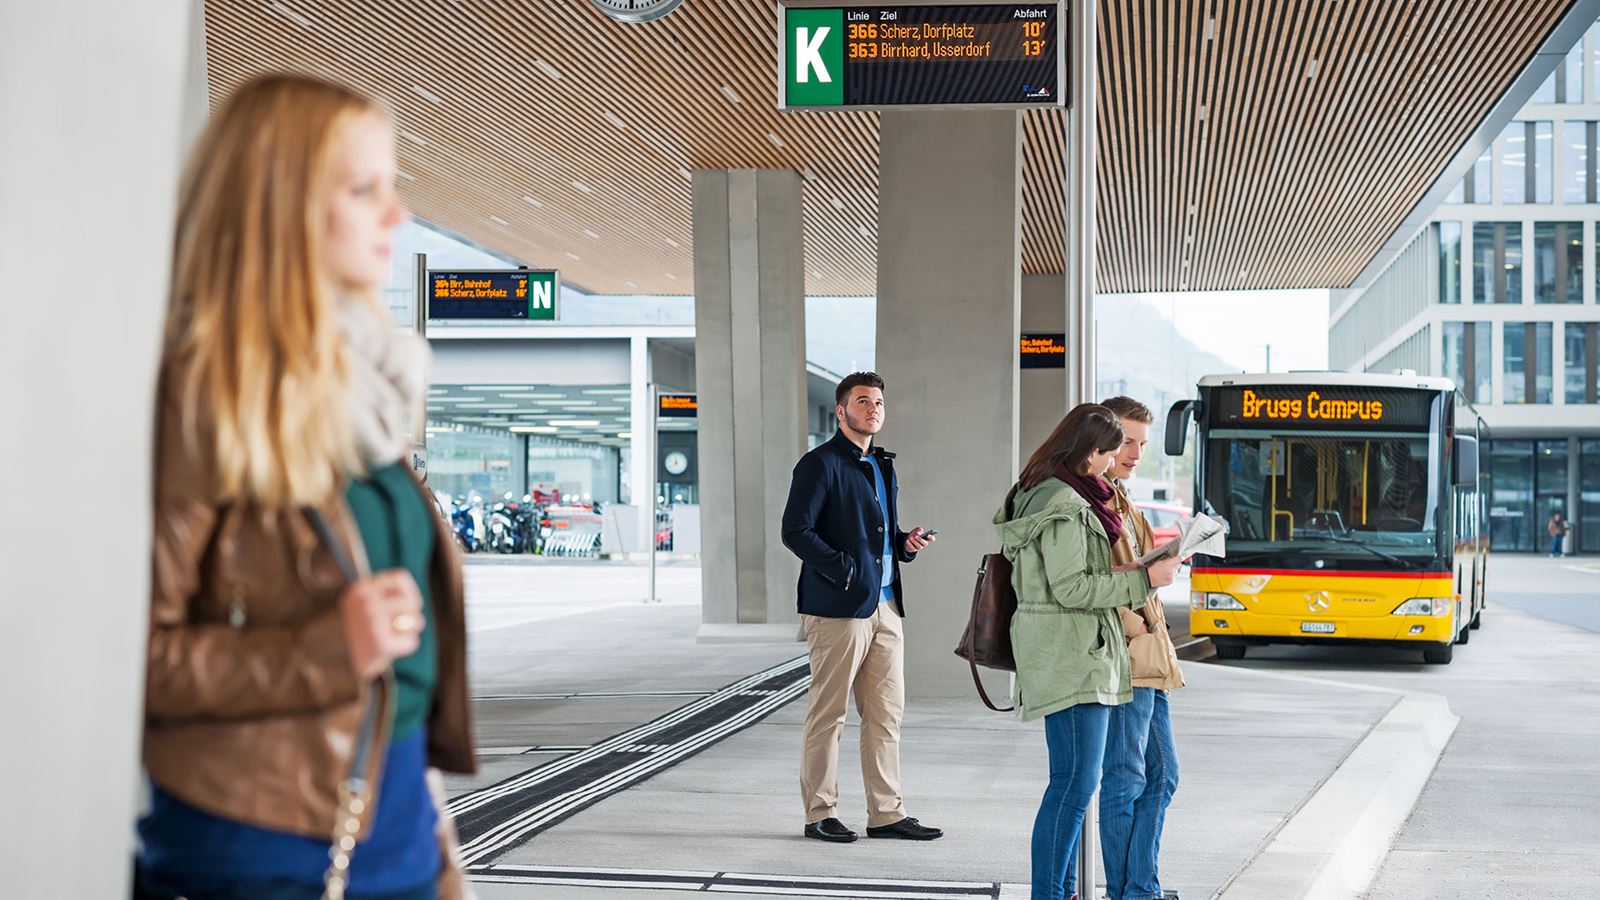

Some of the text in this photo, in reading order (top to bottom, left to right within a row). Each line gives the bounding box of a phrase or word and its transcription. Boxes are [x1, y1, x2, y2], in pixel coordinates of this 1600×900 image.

[848, 9, 1047, 21] Linie Ziel Abfahrt
[848, 24, 878, 39] 366
[880, 23, 921, 41] Scherz,
[923, 23, 974, 40] Dorfplatz
[796, 27, 832, 83] K
[848, 43, 878, 58] 363
[881, 42, 931, 59] Birrhard,
[933, 41, 991, 57] Usserdorf
[465, 280, 491, 289] Bahnhof
[450, 289, 475, 299] Scherz,
[476, 289, 507, 298] Dorfplatz
[533, 281, 551, 309] N
[1243, 390, 1383, 420] Brugg Campus
